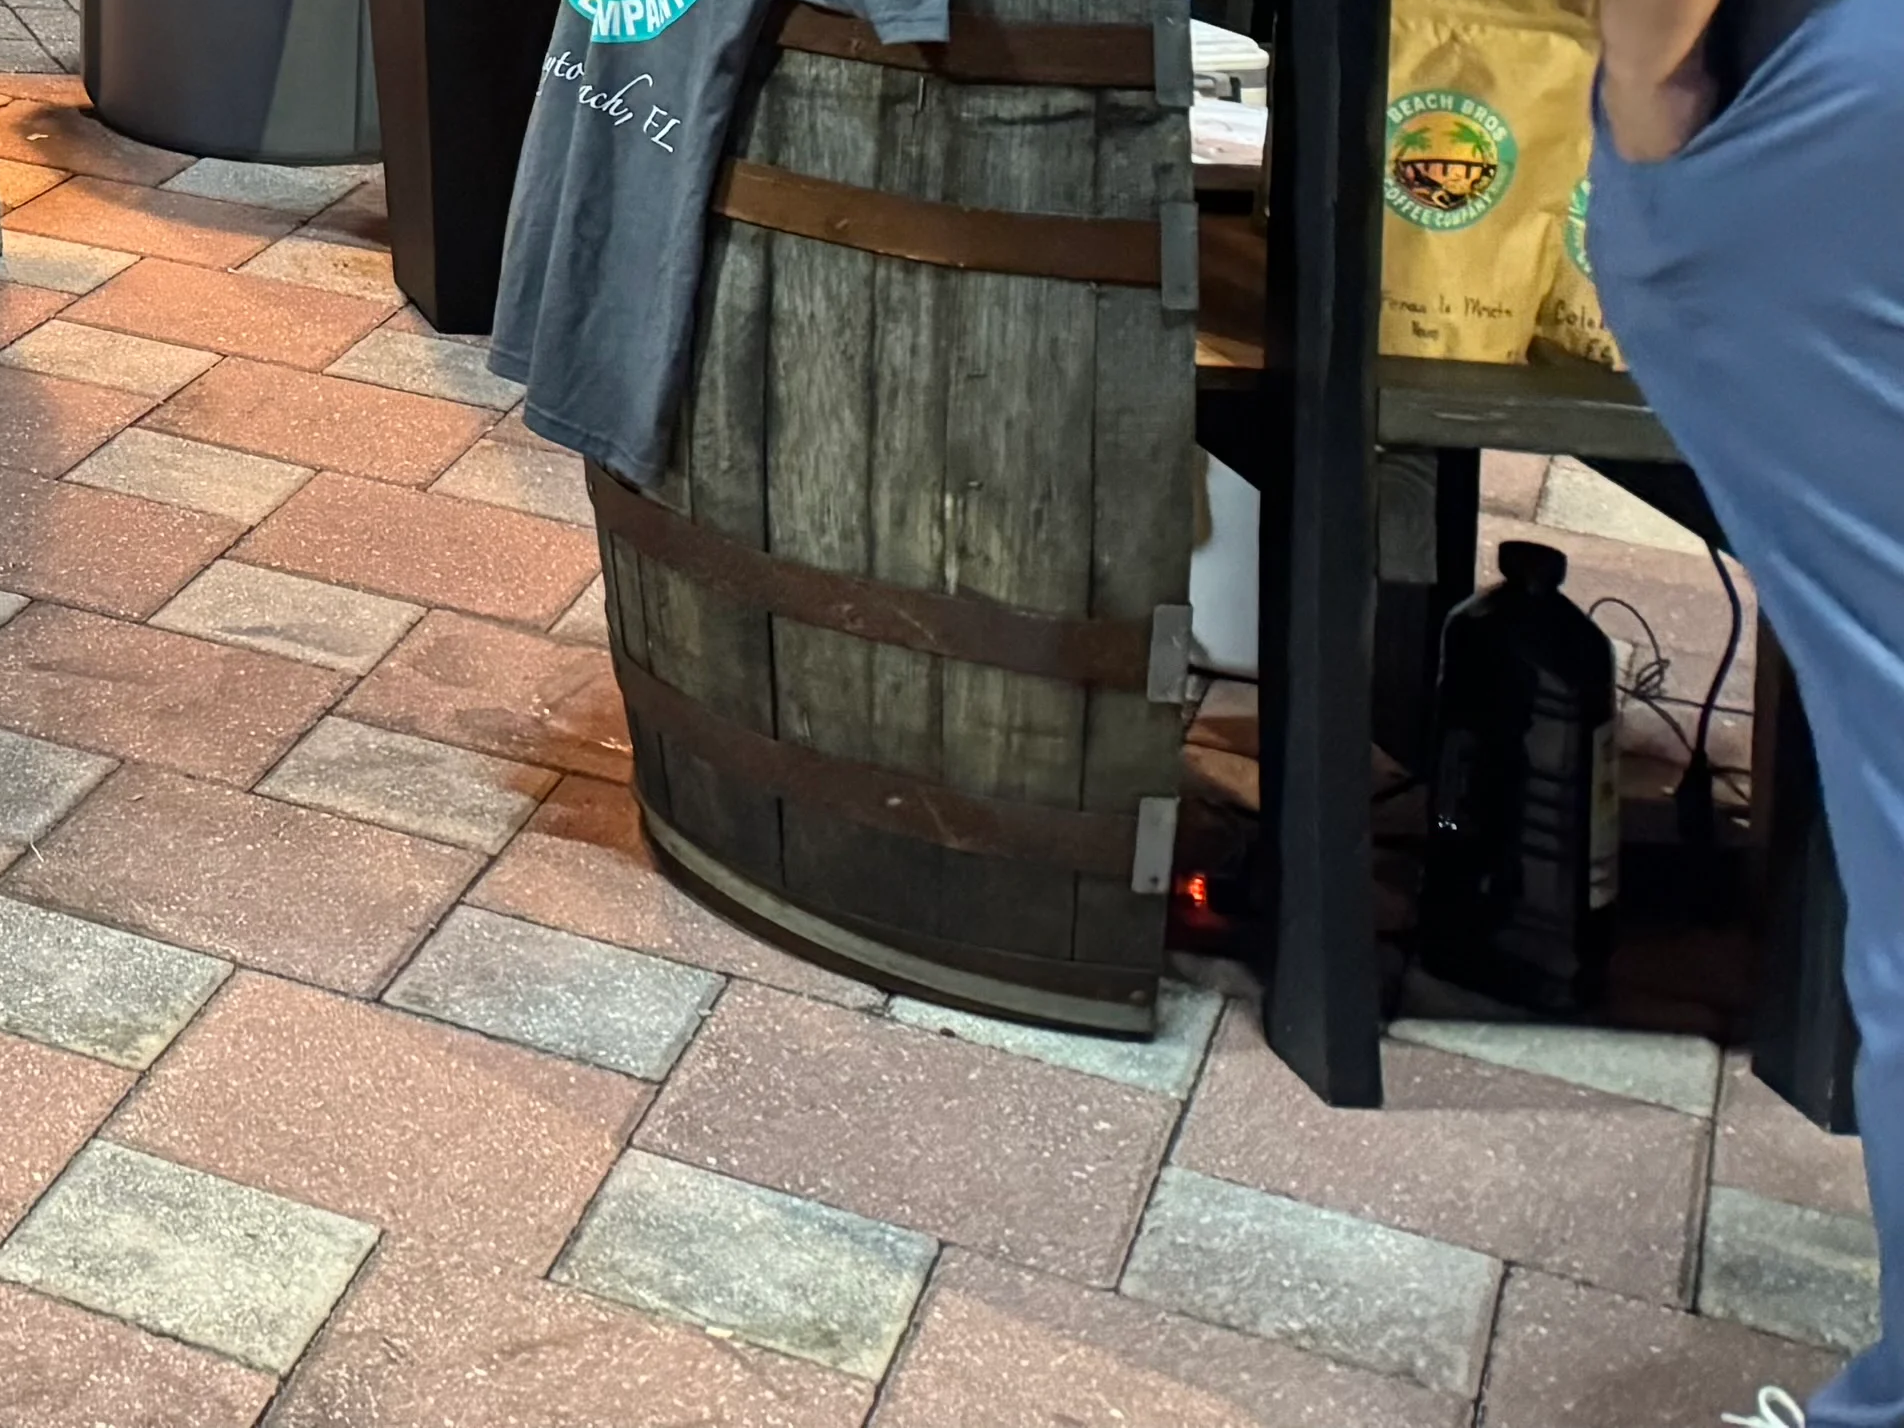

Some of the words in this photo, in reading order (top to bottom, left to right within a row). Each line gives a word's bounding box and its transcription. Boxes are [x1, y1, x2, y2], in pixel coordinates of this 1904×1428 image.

[642, 104, 682, 154] FL
[1386, 93, 1455, 124] BEACH
[1460, 98, 1507, 142] BROS
[1383, 177, 1432, 226] COFFEE
